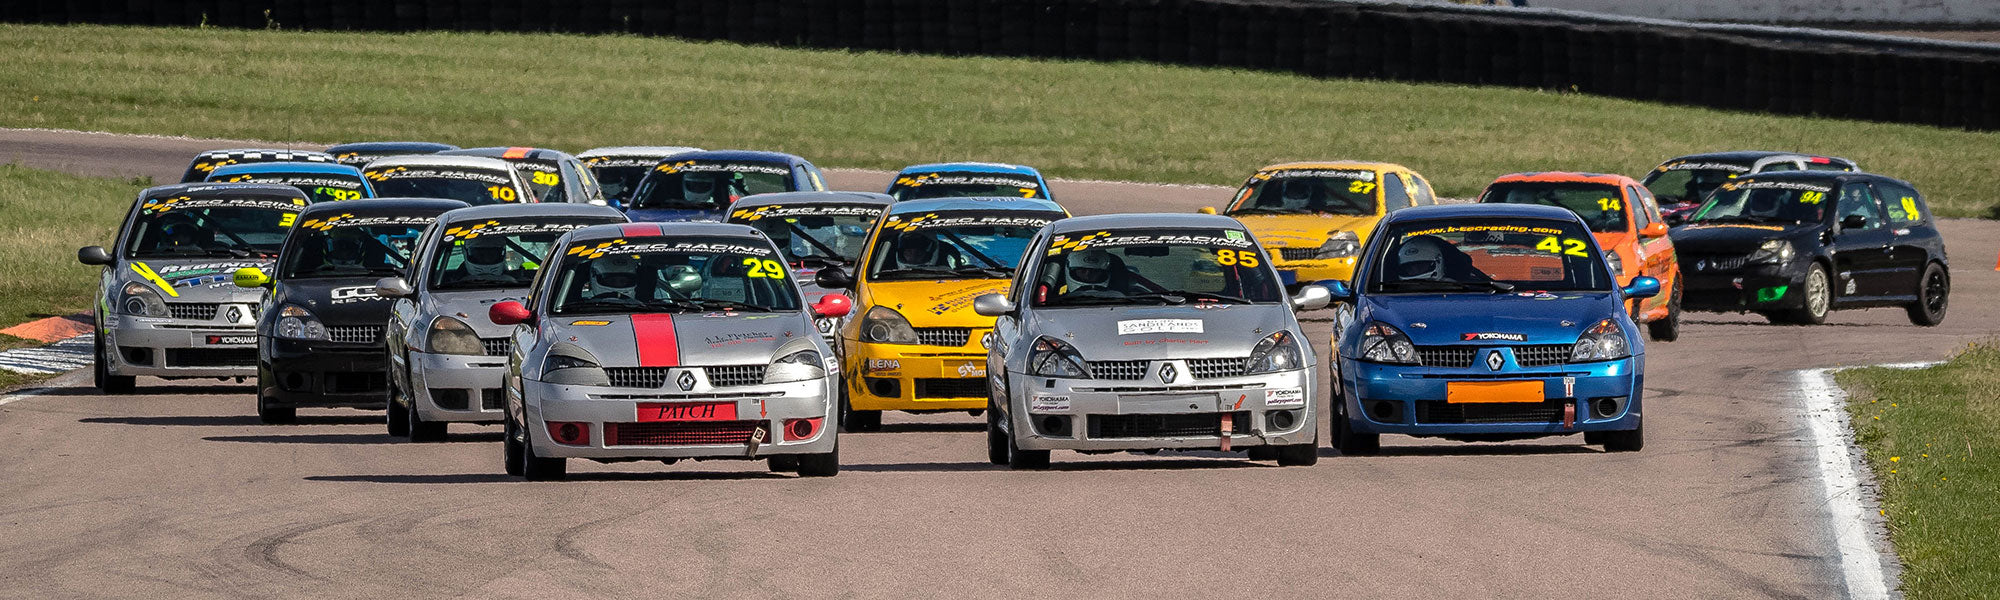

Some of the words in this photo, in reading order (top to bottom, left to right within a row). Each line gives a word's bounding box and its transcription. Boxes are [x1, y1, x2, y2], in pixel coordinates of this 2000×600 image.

[532, 171, 559, 186] 30
[488, 185, 516, 201] 10
[1348, 180, 1376, 195] 27
[1800, 190, 1824, 205] 94
[164, 199, 224, 207] K-TEC
[229, 199, 305, 210] RACING
[1597, 197, 1622, 211] 14
[820, 207, 881, 216] RACIN
[279, 212, 298, 227] 3
[326, 217, 389, 226] K-TEC
[909, 217, 975, 227] K-TEC
[979, 217, 1053, 226] RACIN
[470, 224, 537, 234] K-TEC
[1407, 225, 1563, 237] www.k-tecracing.com
[1079, 235, 1151, 246] K-TEC
[1157, 235, 1253, 247] RACING
[1092, 239, 1164, 248] PERFORMANCE
[1211, 241, 1248, 249] TUNING
[1536, 236, 1589, 258] 42
[595, 243, 668, 253] K-TEC
[670, 243, 772, 255] RACING
[609, 247, 681, 255] PERFORMANCE
[729, 248, 767, 257] TUNING
[1217, 249, 1260, 268] 85
[742, 257, 786, 280] 29
[1478, 333, 1523, 341] YOKOHAMA
[658, 404, 716, 419] PATCH
